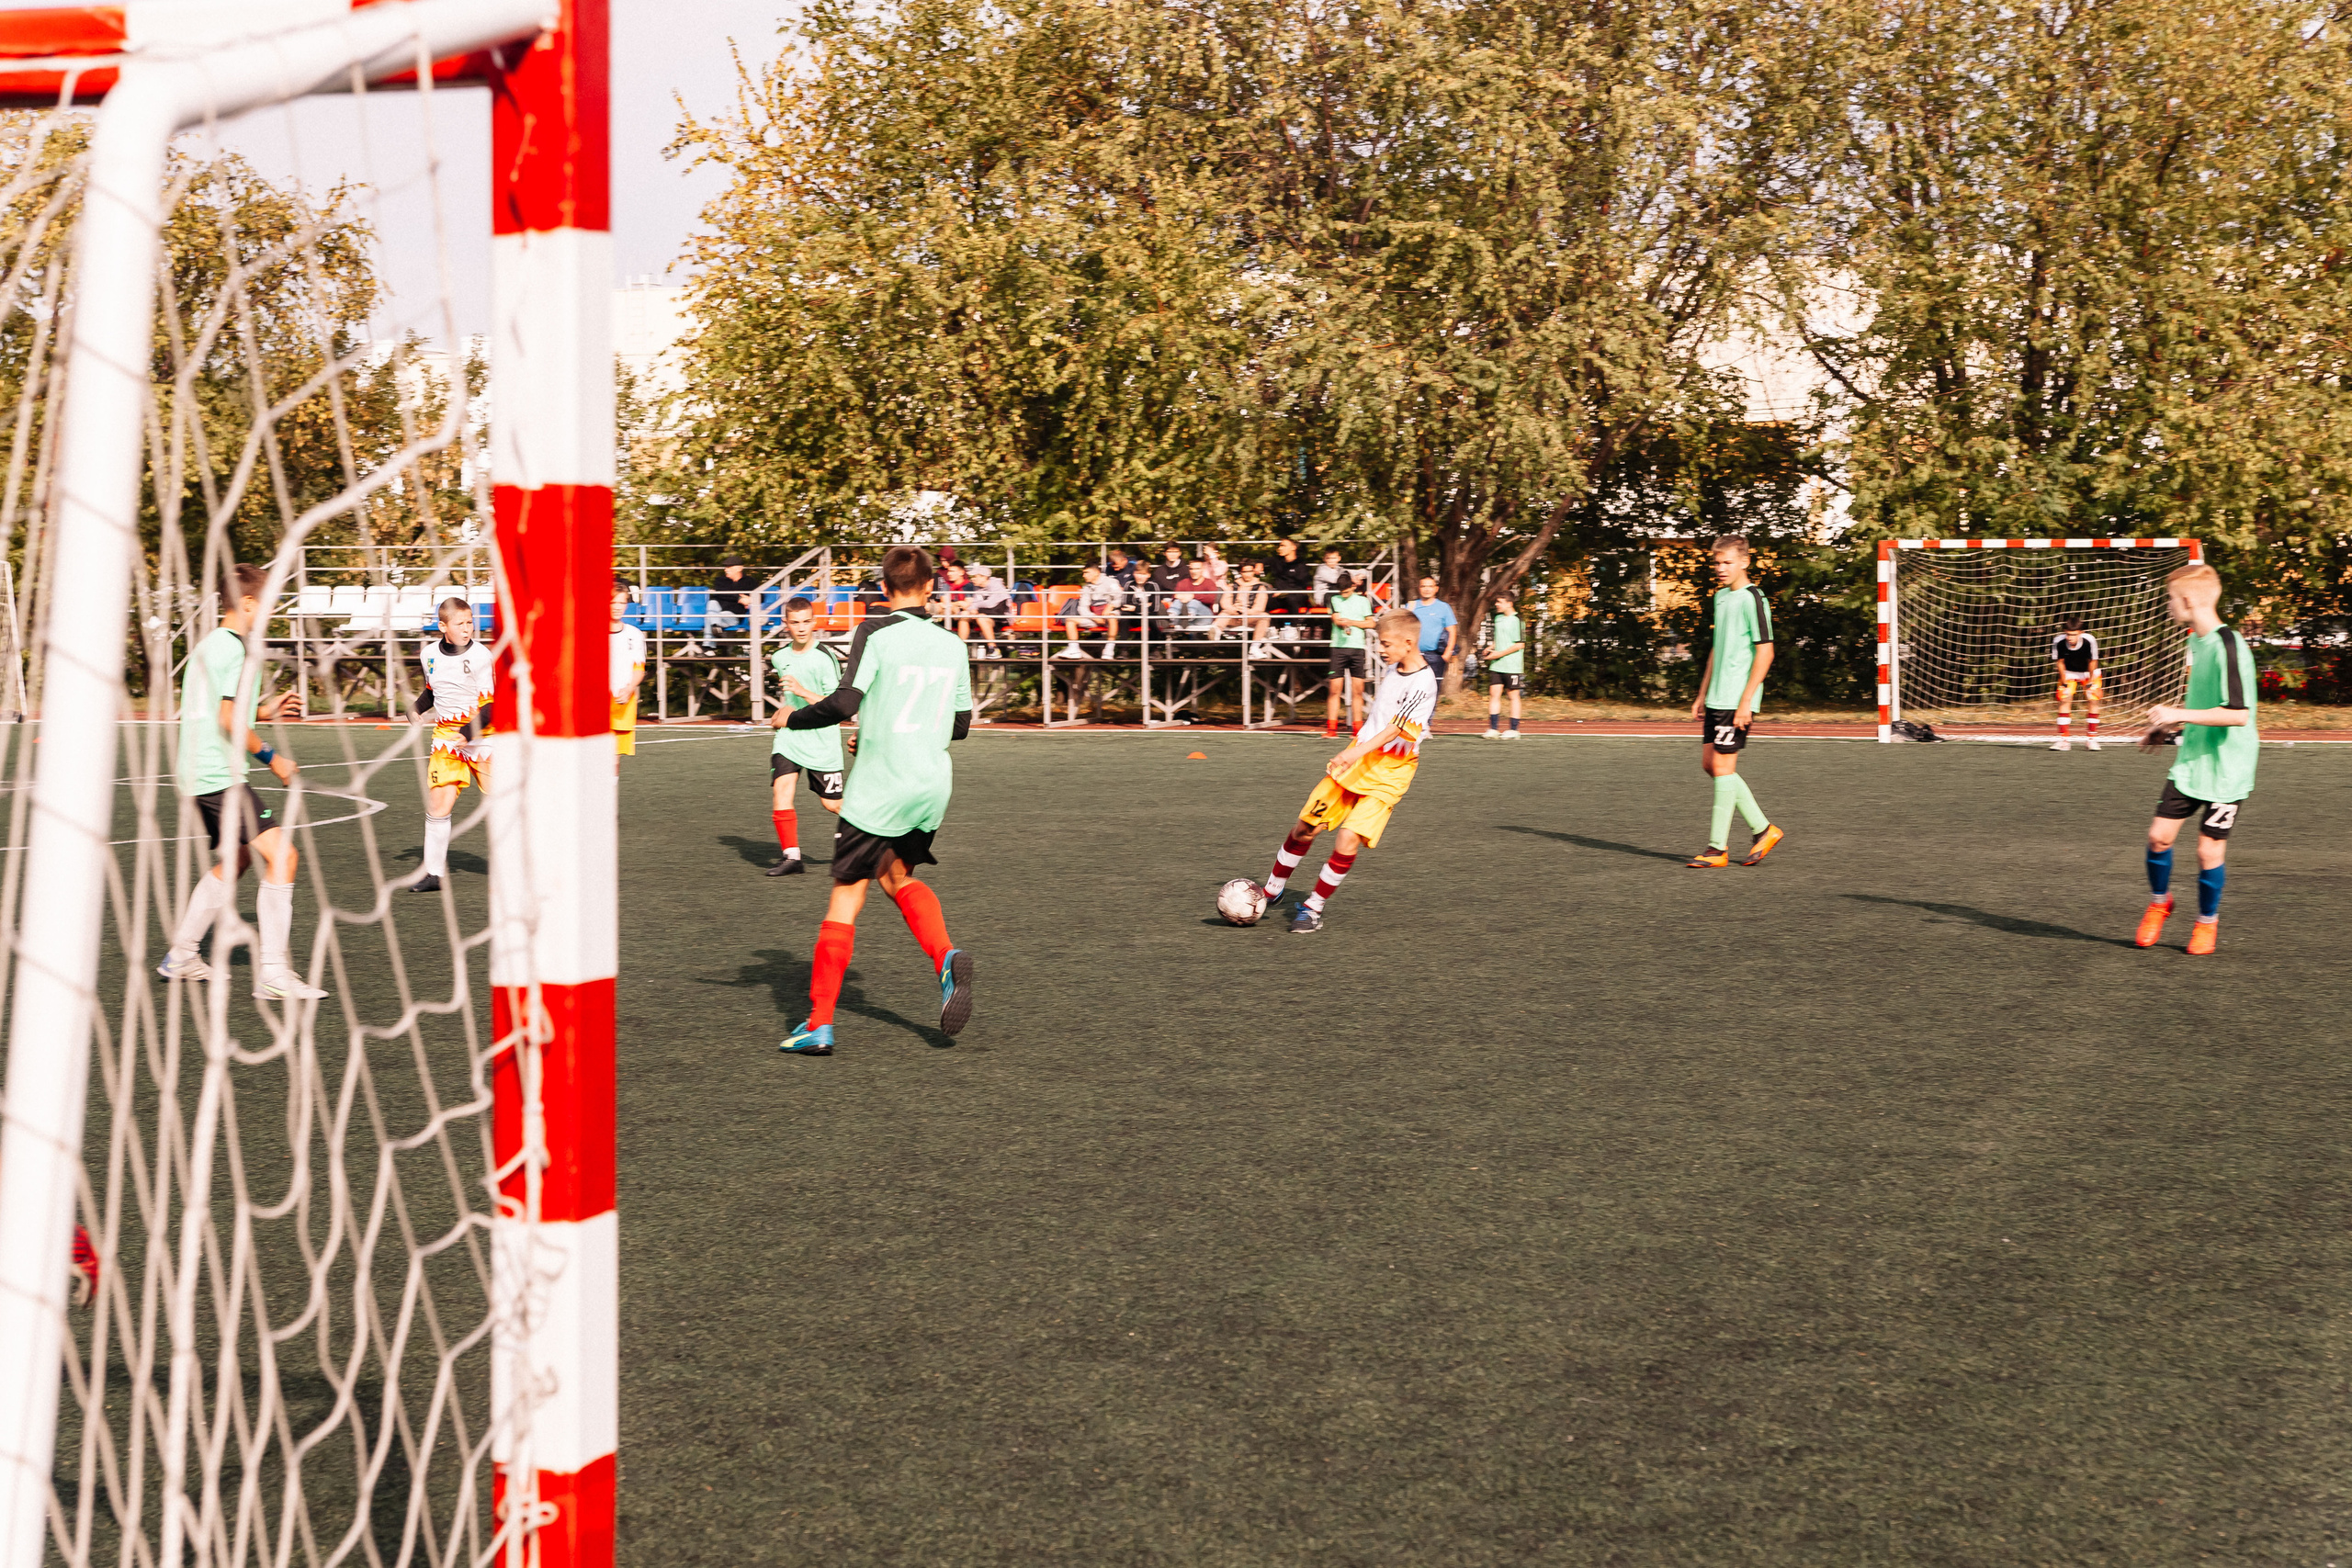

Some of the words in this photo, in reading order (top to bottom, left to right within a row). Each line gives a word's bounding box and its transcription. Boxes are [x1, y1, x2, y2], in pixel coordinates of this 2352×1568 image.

[892, 665, 956, 733] 27
[1713, 725, 1736, 746] 22
[1310, 799, 1328, 818] 12
[2204, 802, 2238, 829] 23
